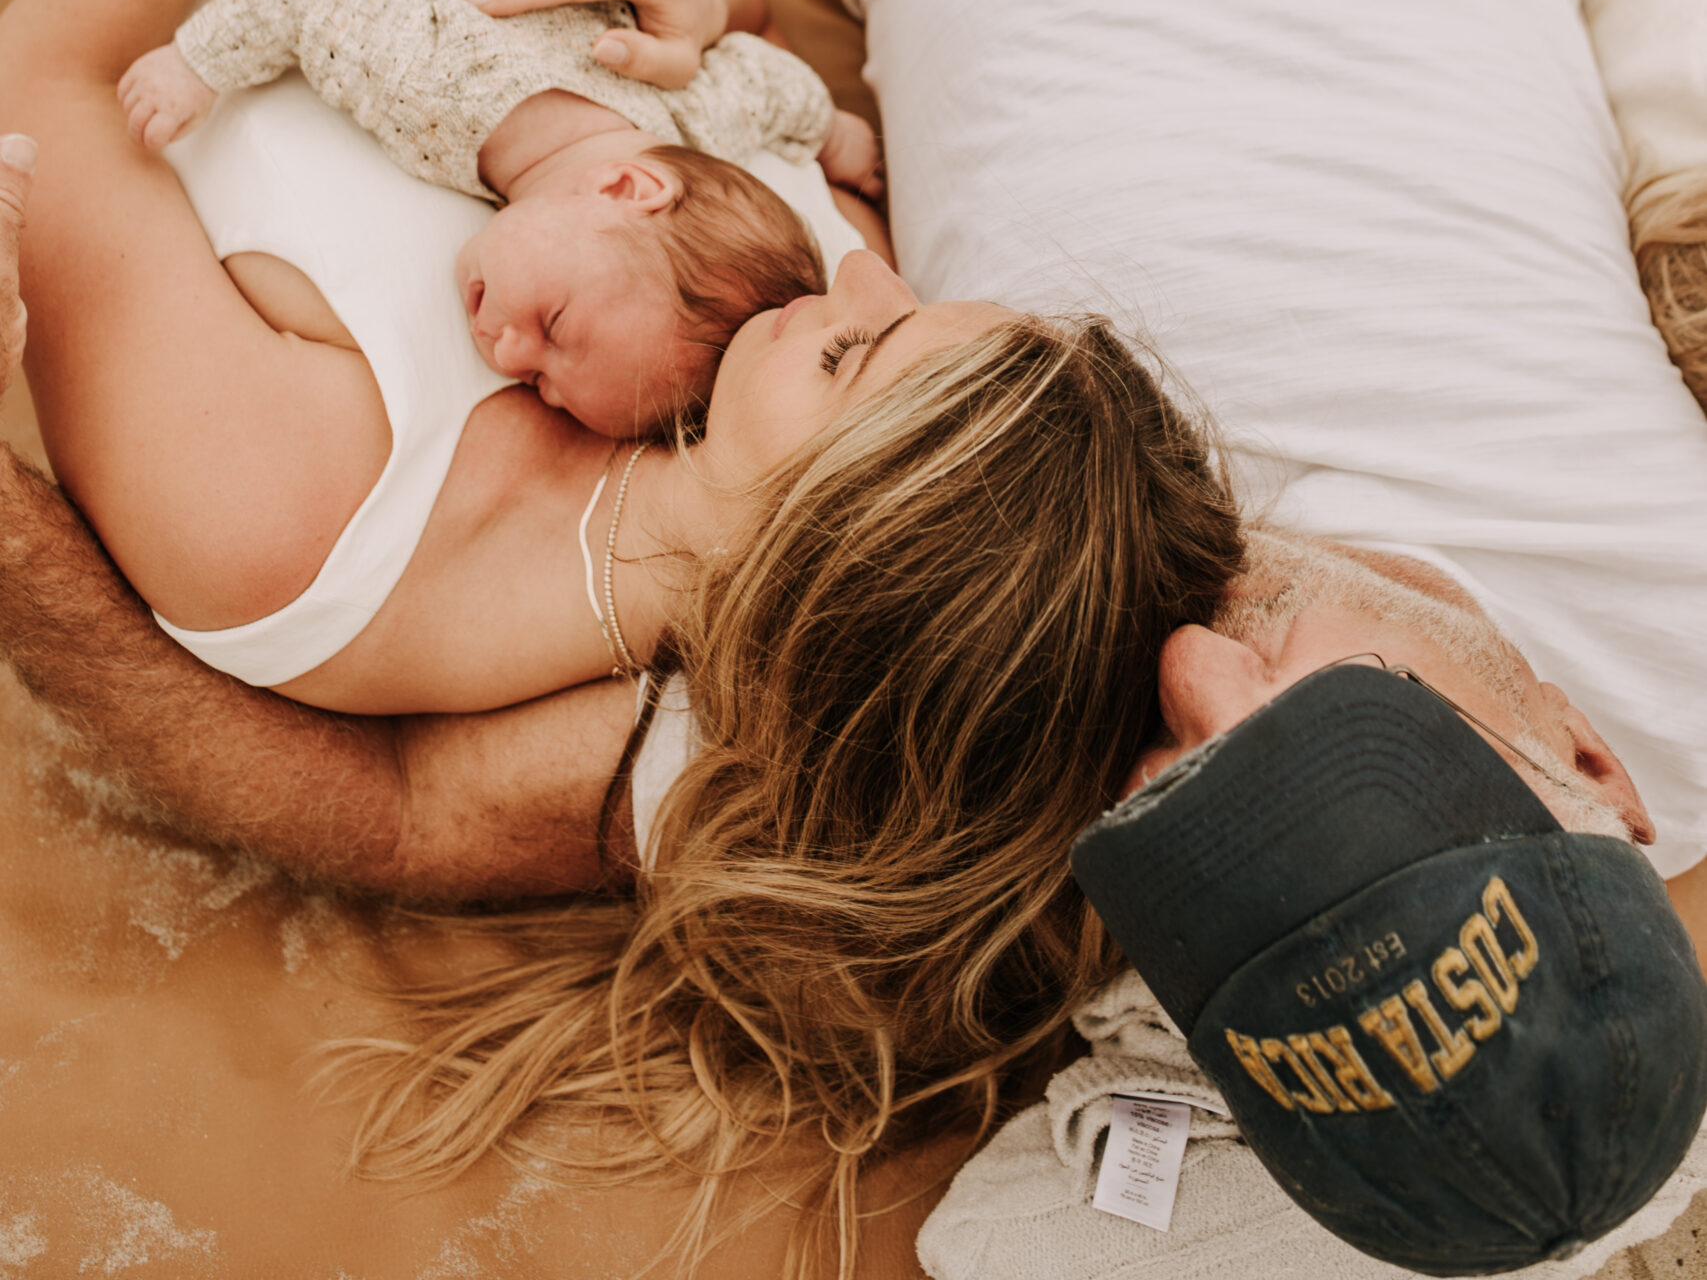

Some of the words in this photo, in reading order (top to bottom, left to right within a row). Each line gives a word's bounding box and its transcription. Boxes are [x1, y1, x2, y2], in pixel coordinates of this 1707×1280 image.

[1296, 959, 1365, 1008] 2013
[1358, 875, 1539, 1094] COSTA
[1365, 931, 1407, 971] Est
[1225, 1025, 1397, 1114] RICA
